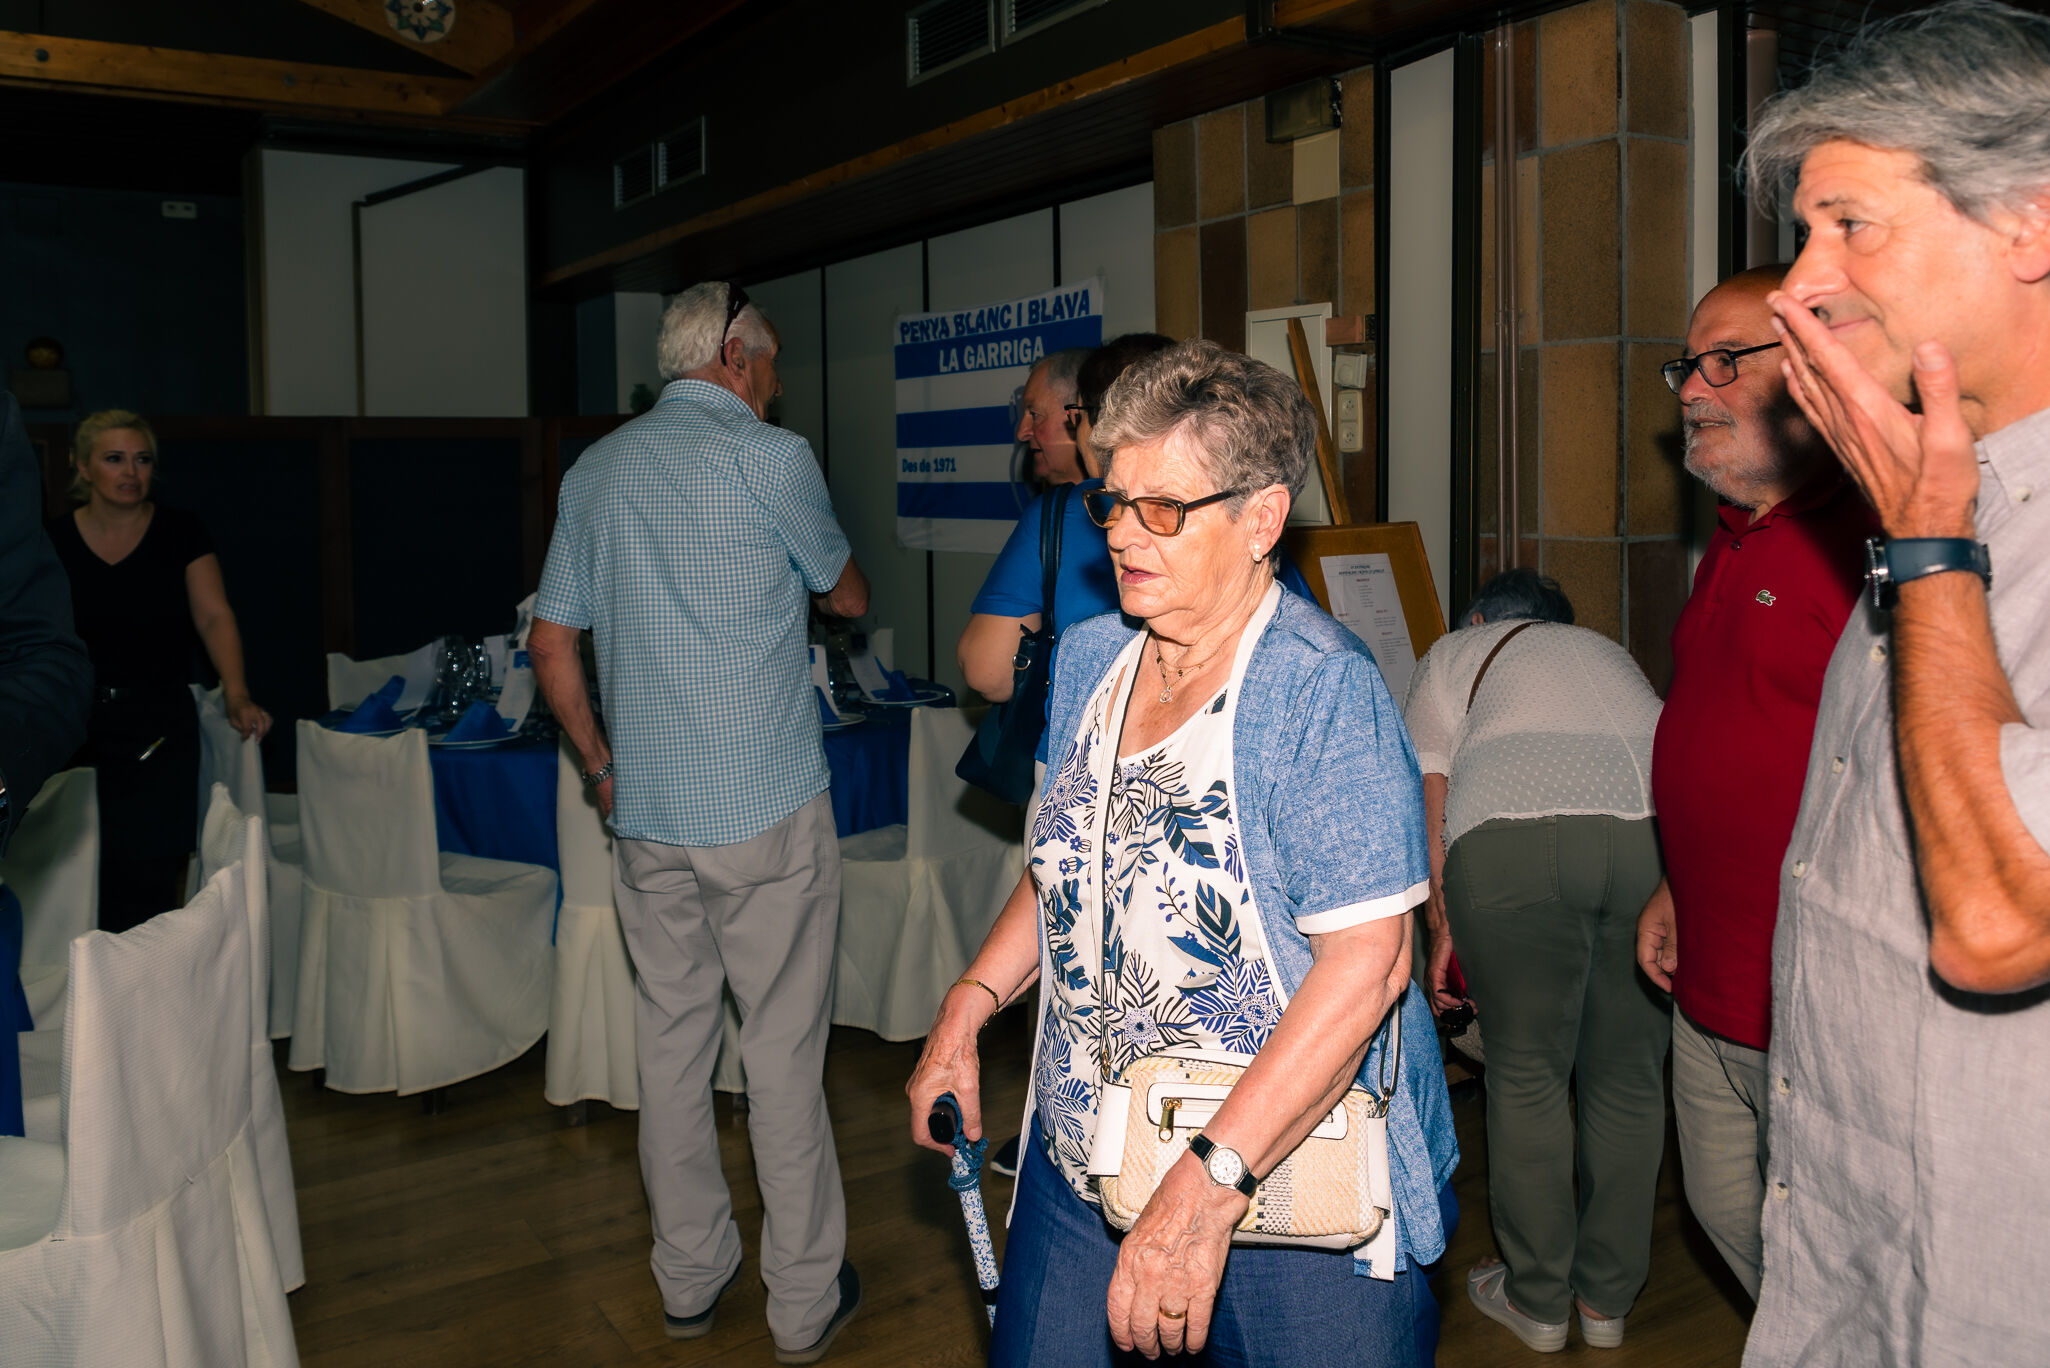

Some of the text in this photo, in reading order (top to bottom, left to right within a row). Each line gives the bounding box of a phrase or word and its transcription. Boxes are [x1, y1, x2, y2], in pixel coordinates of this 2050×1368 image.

[900, 289, 1090, 344] PENYA BLANC I BLAVA
[939, 336, 1044, 373] LA GARRIGA
[902, 457, 957, 473] Des de 1971
